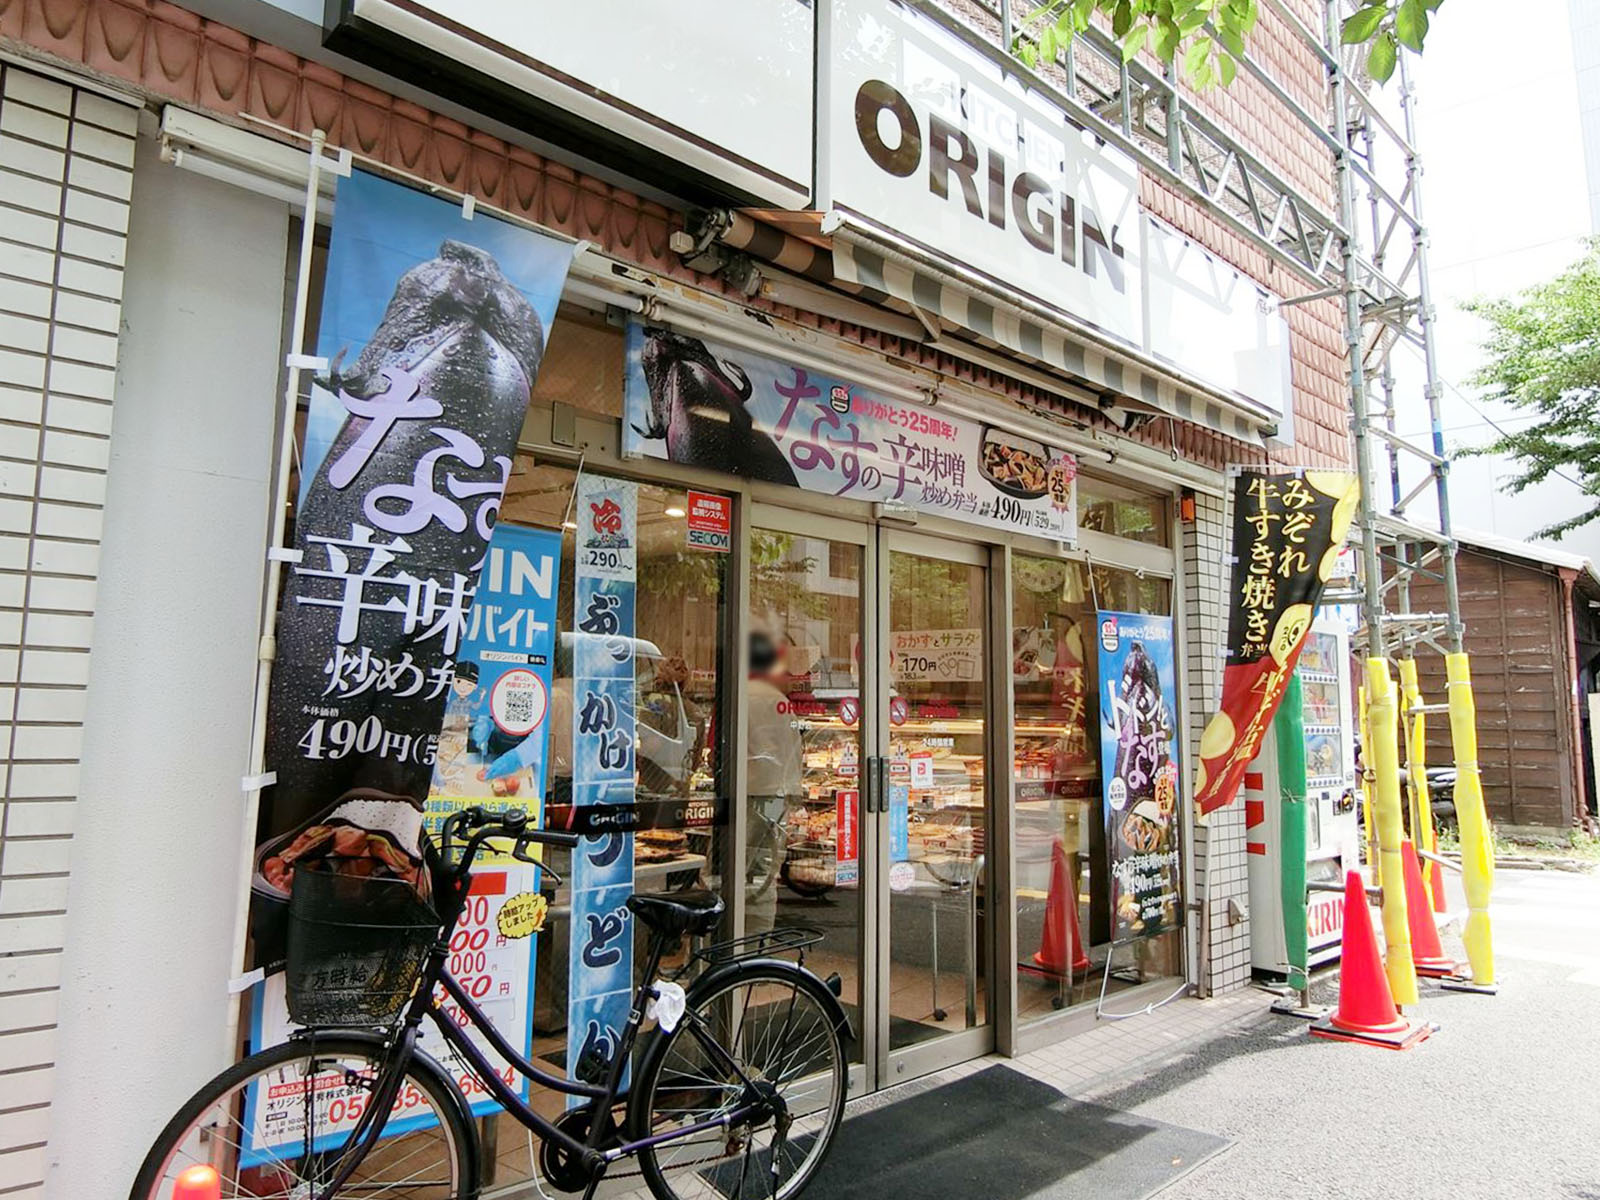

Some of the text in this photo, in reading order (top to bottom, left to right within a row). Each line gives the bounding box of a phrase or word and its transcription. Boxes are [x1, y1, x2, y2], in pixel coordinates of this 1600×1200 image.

[855, 79, 1125, 295] ORIGIN
[690, 530, 728, 547] SECOM
[1277, 479, 1316, 578] みぞれ
[1241, 478, 1281, 642] 牛すき焼き
[467, 603, 549, 648] バイト
[897, 633, 980, 648] おかずとサラダ
[902, 657, 937, 672] 170円
[1240, 643, 1268, 657] 弁当
[297, 715, 413, 763] 490円
